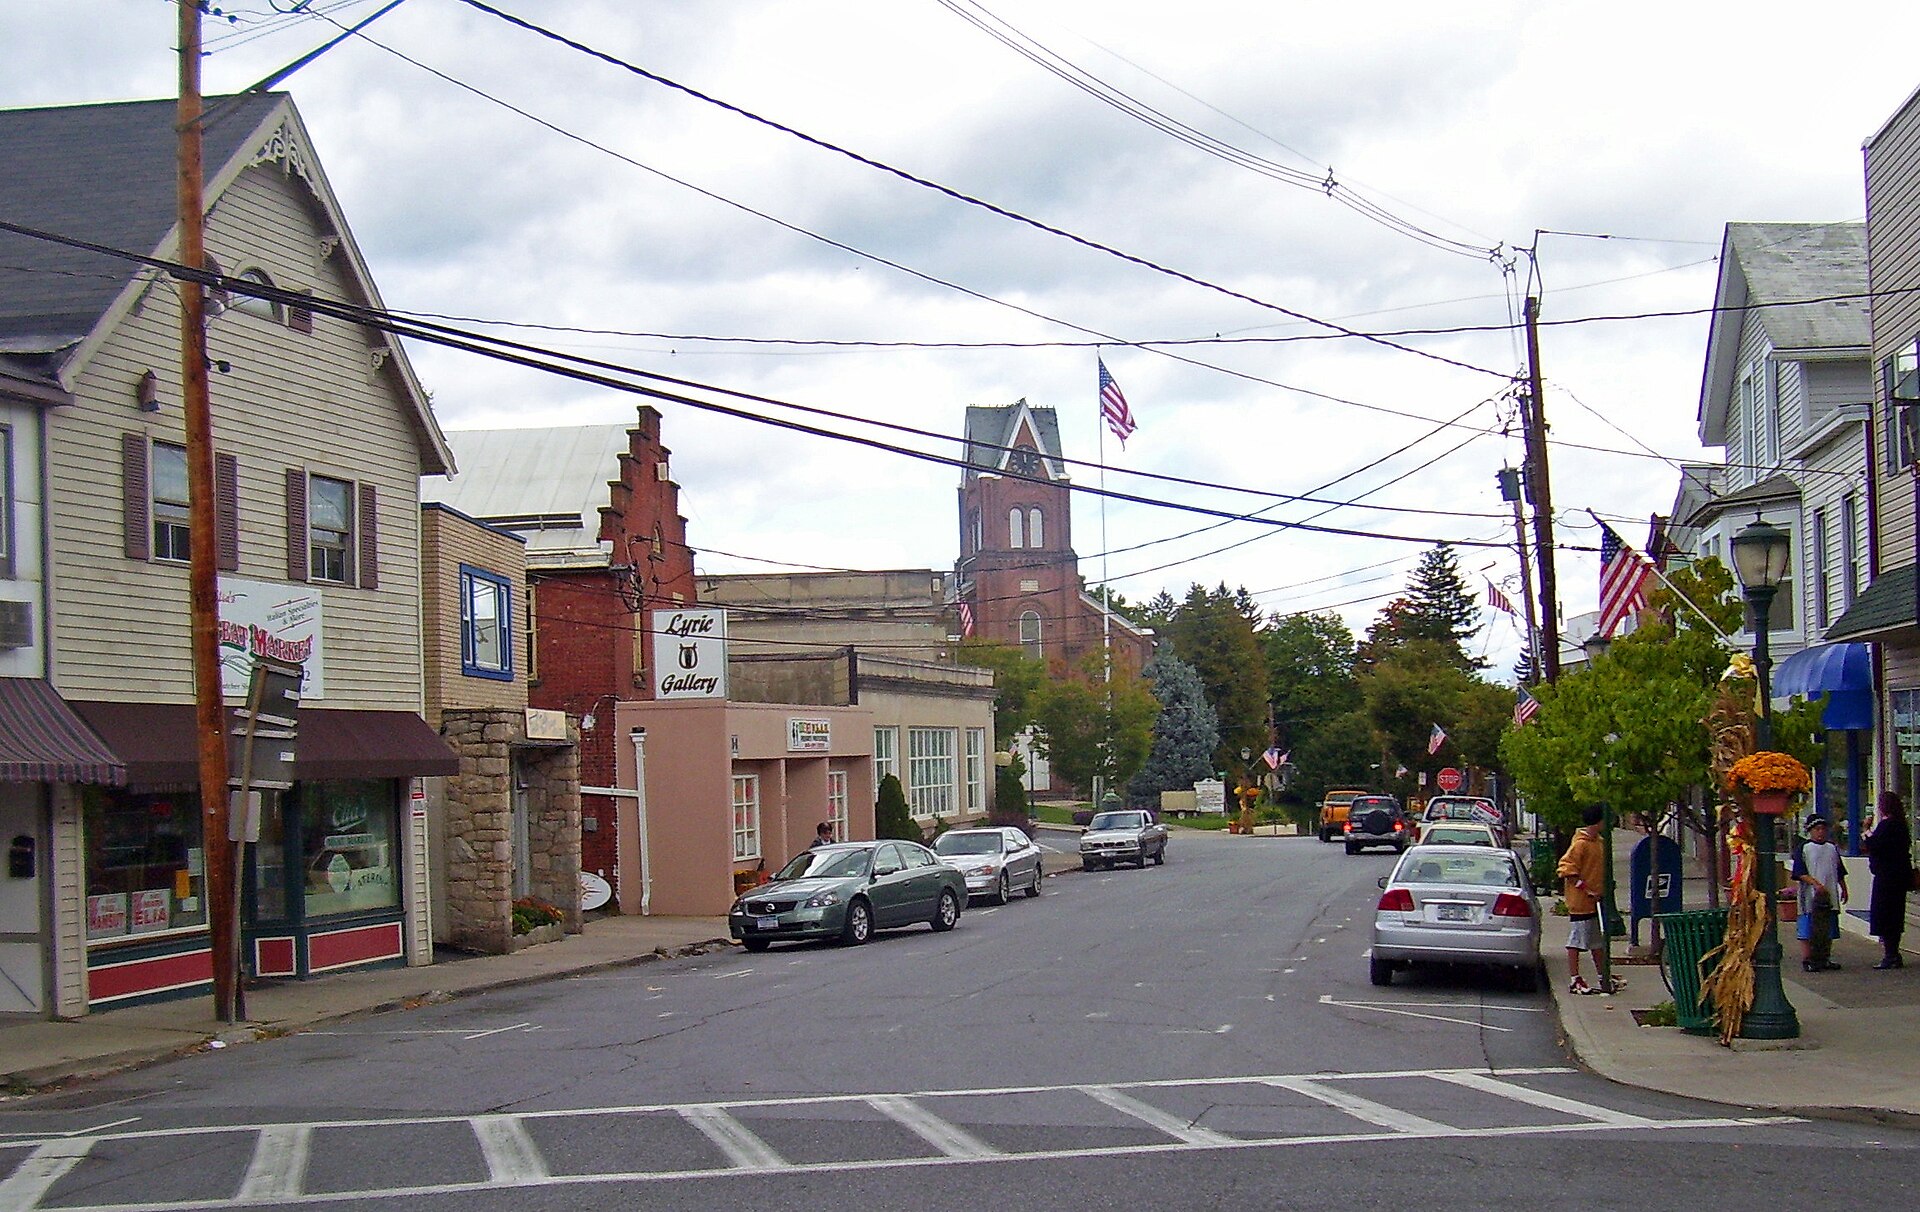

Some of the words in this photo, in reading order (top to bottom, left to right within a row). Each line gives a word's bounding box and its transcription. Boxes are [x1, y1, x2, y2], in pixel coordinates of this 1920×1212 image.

[218, 620, 248, 649] EAT
[664, 613, 714, 638] Lyric
[661, 673, 719, 695] Gallery
[1440, 774, 1459, 784] STOP
